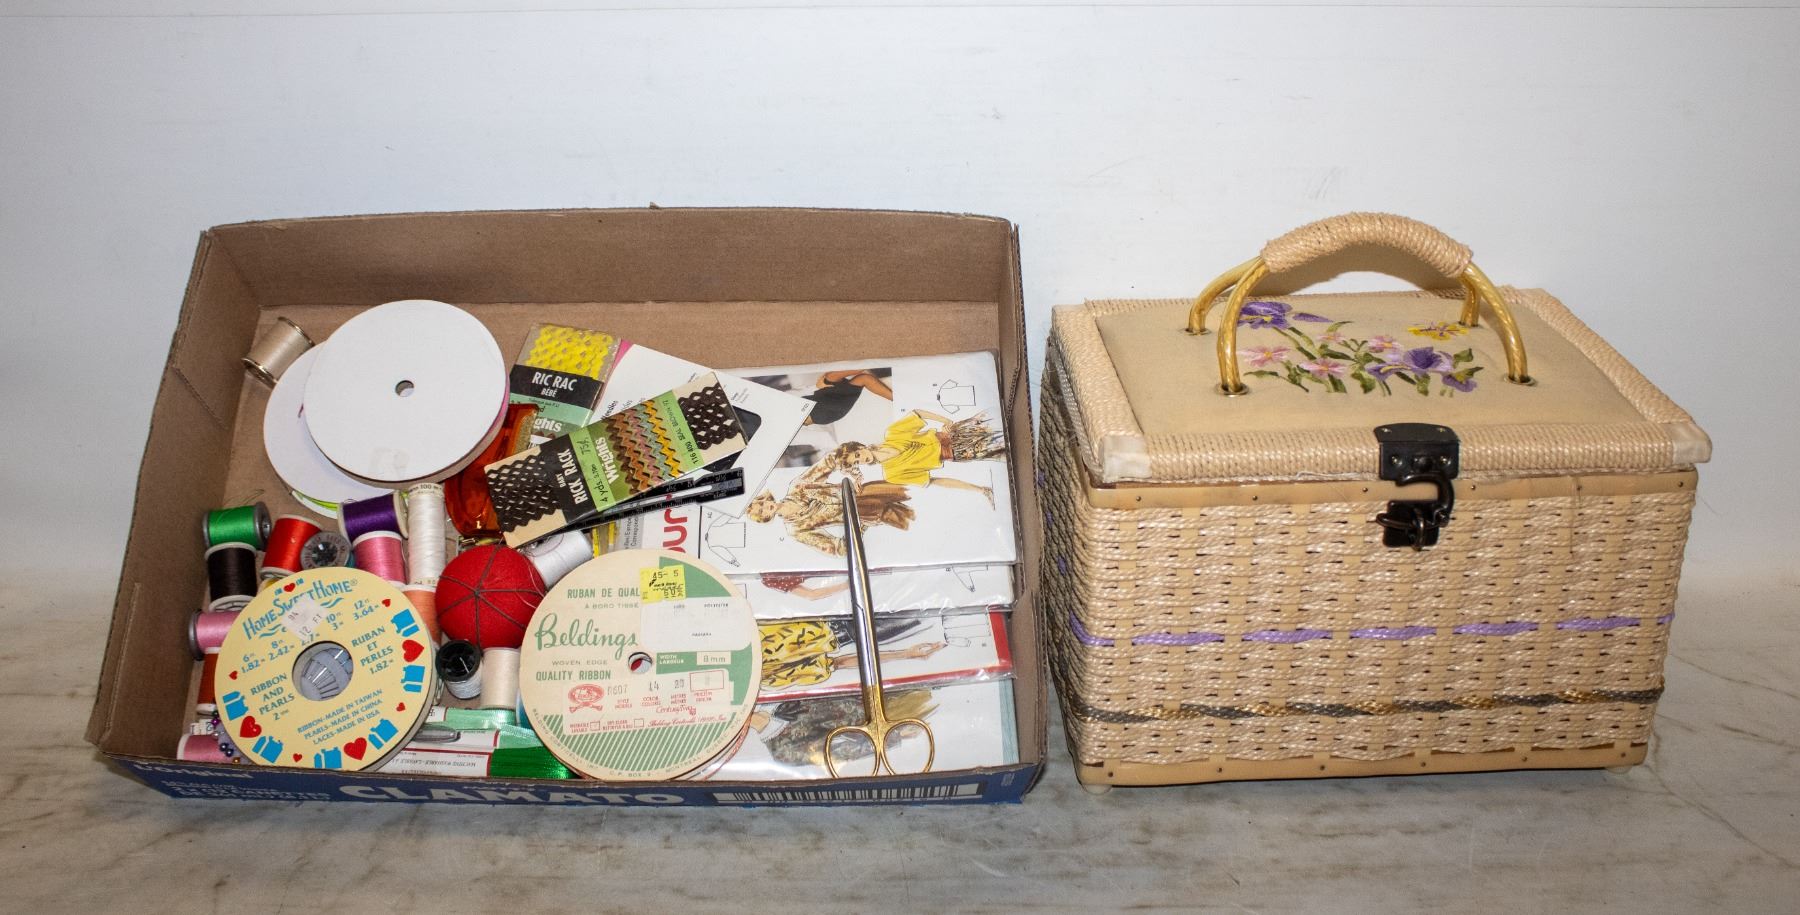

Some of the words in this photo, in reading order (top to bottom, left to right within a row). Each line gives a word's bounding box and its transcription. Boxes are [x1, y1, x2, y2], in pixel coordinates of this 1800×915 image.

[532, 372, 552, 386] RIC
[552, 375, 577, 391] RAC
[541, 387, 557, 397] BÉBÉ
[533, 418, 562, 432] ghts
[556, 448, 579, 478] RACK
[594, 437, 620, 485] Wrights
[569, 478, 589, 505] RICK
[567, 588, 596, 599] RUBAN
[601, 588, 613, 598] DE
[617, 587, 640, 598] QUAL
[354, 600, 364, 610] 12
[326, 613, 336, 624] 10
[353, 606, 375, 621] 3.64
[242, 612, 278, 640] HOME
[333, 621, 339, 631] 3
[351, 625, 386, 648] RUBAN
[534, 612, 638, 660] Beldings
[268, 645, 291, 661] 2.42
[271, 640, 279, 650] 8
[367, 641, 378, 652] ET
[242, 653, 250, 663] 6
[360, 646, 394, 667] PERLES
[241, 659, 260, 674] 1.82
[369, 659, 389, 675] 1.82
[535, 671, 573, 681] QUALITY
[579, 670, 612, 681] RIBBON
[250, 673, 288, 696] RIBBON
[262, 686, 284, 702] AND
[259, 693, 296, 715] PEARLS
[339, 785, 686, 804] CLAMATO
